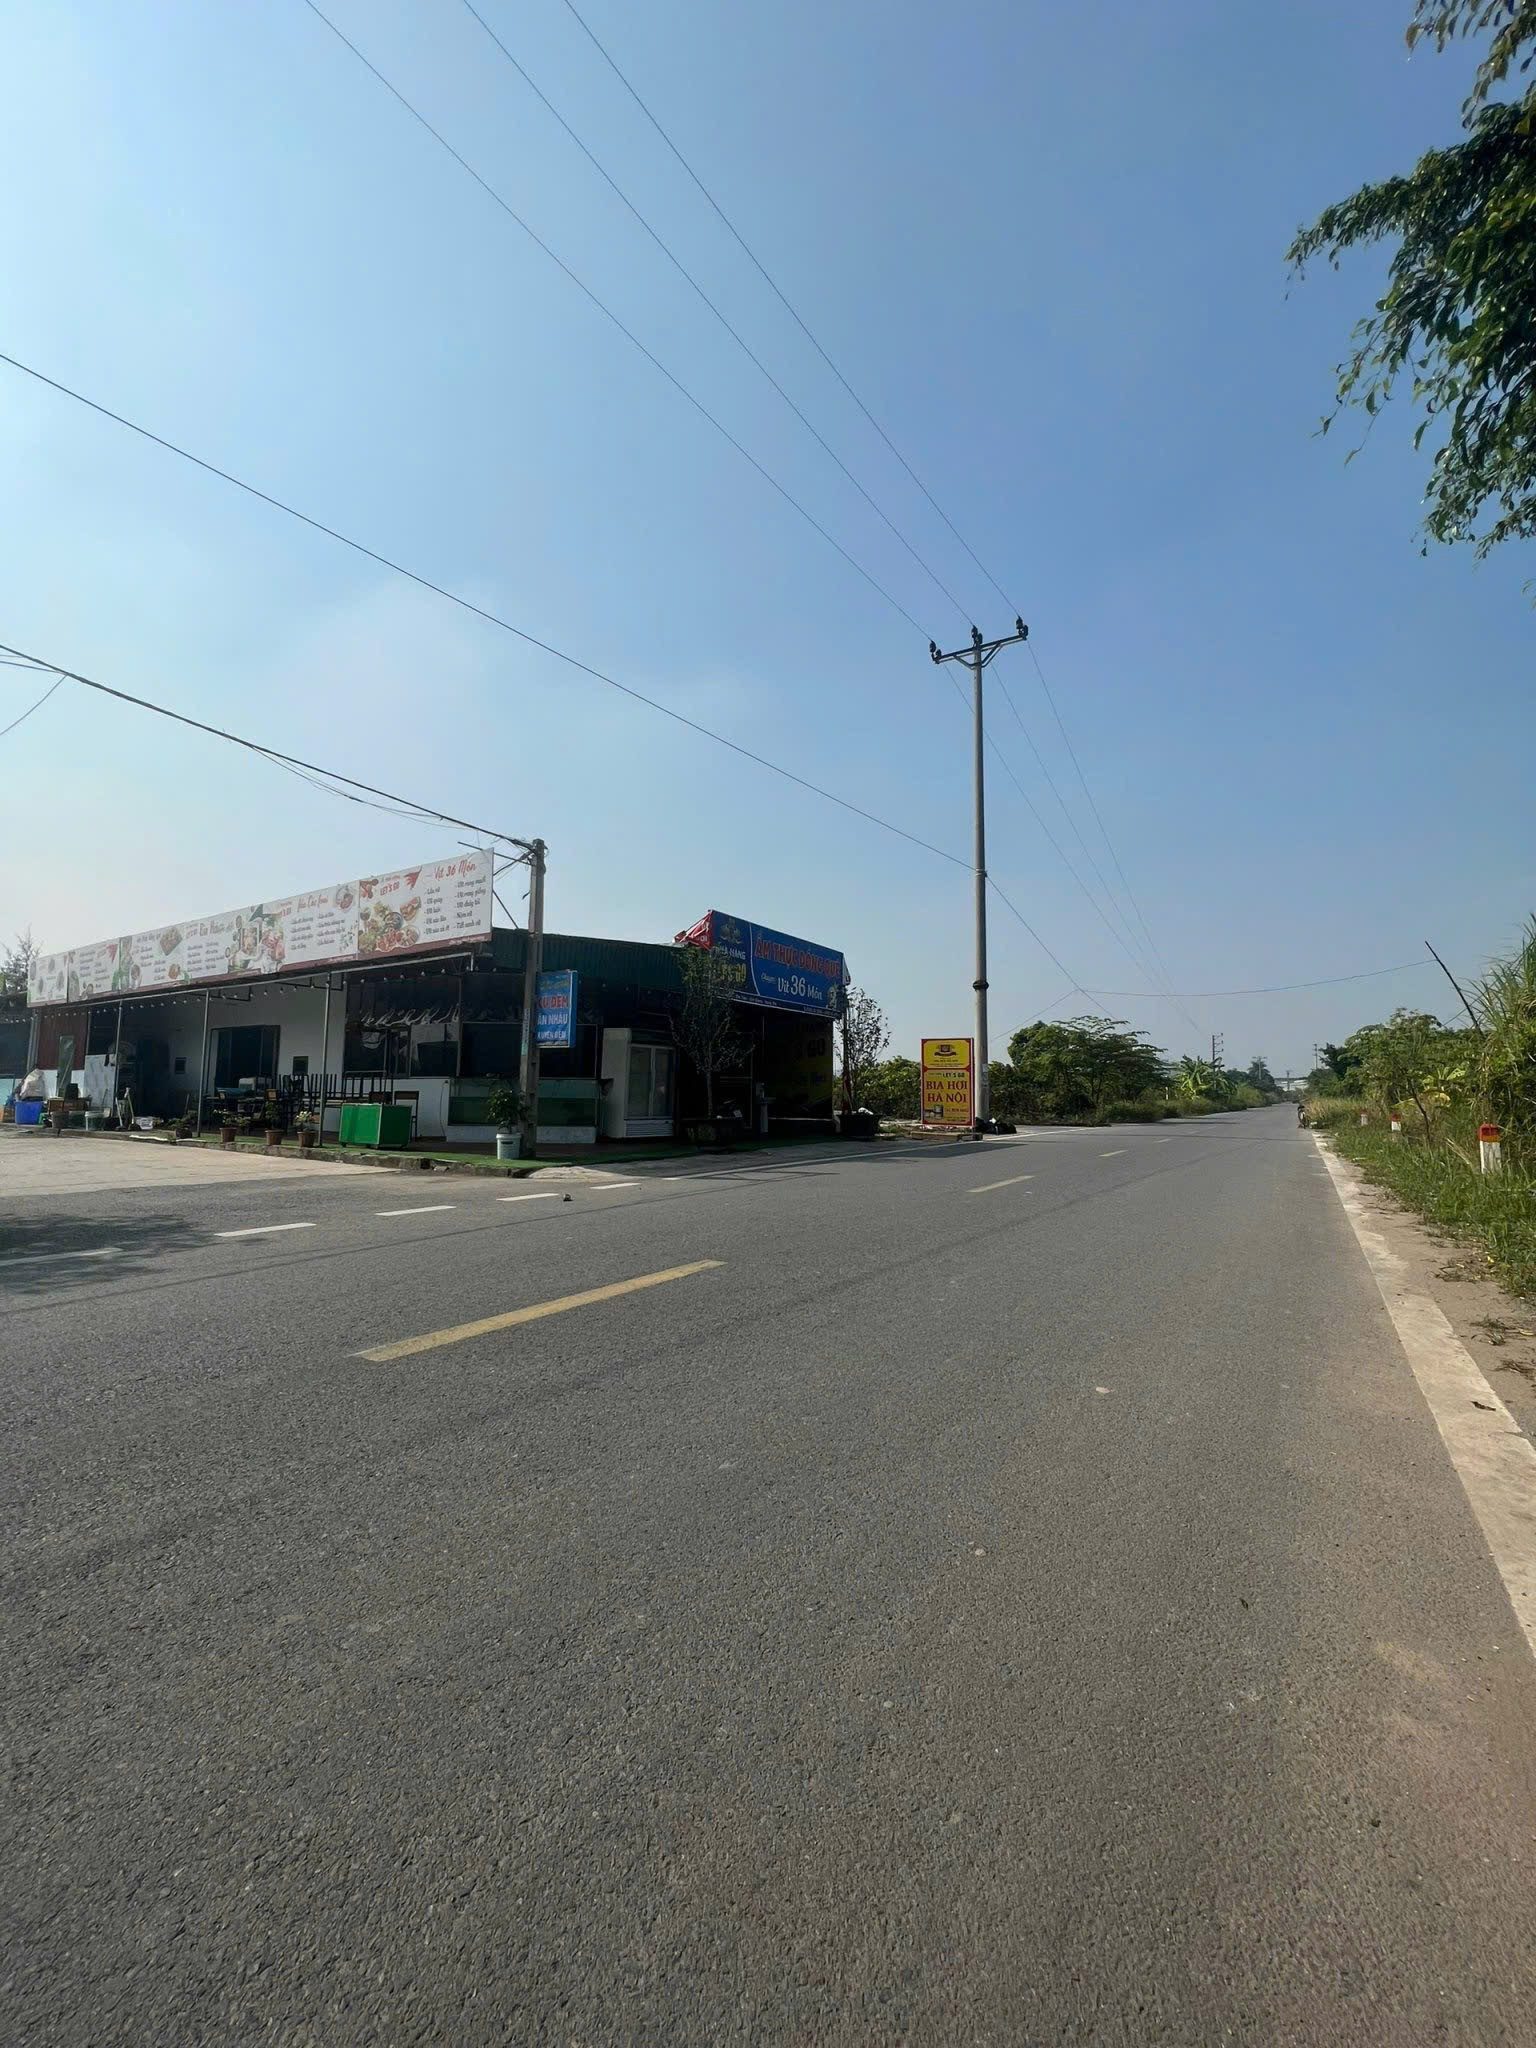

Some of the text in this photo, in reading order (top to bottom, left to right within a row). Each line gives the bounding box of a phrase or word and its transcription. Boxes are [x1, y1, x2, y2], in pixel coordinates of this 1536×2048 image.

[446, 864, 456, 877] 36
[777, 976, 791, 995] Vịt
[791, 974, 806, 997] 36
[807, 985, 823, 1000] Món
[926, 1080, 968, 1091] BIA HƠI
[927, 1091, 967, 1103] HÀ NỘI
